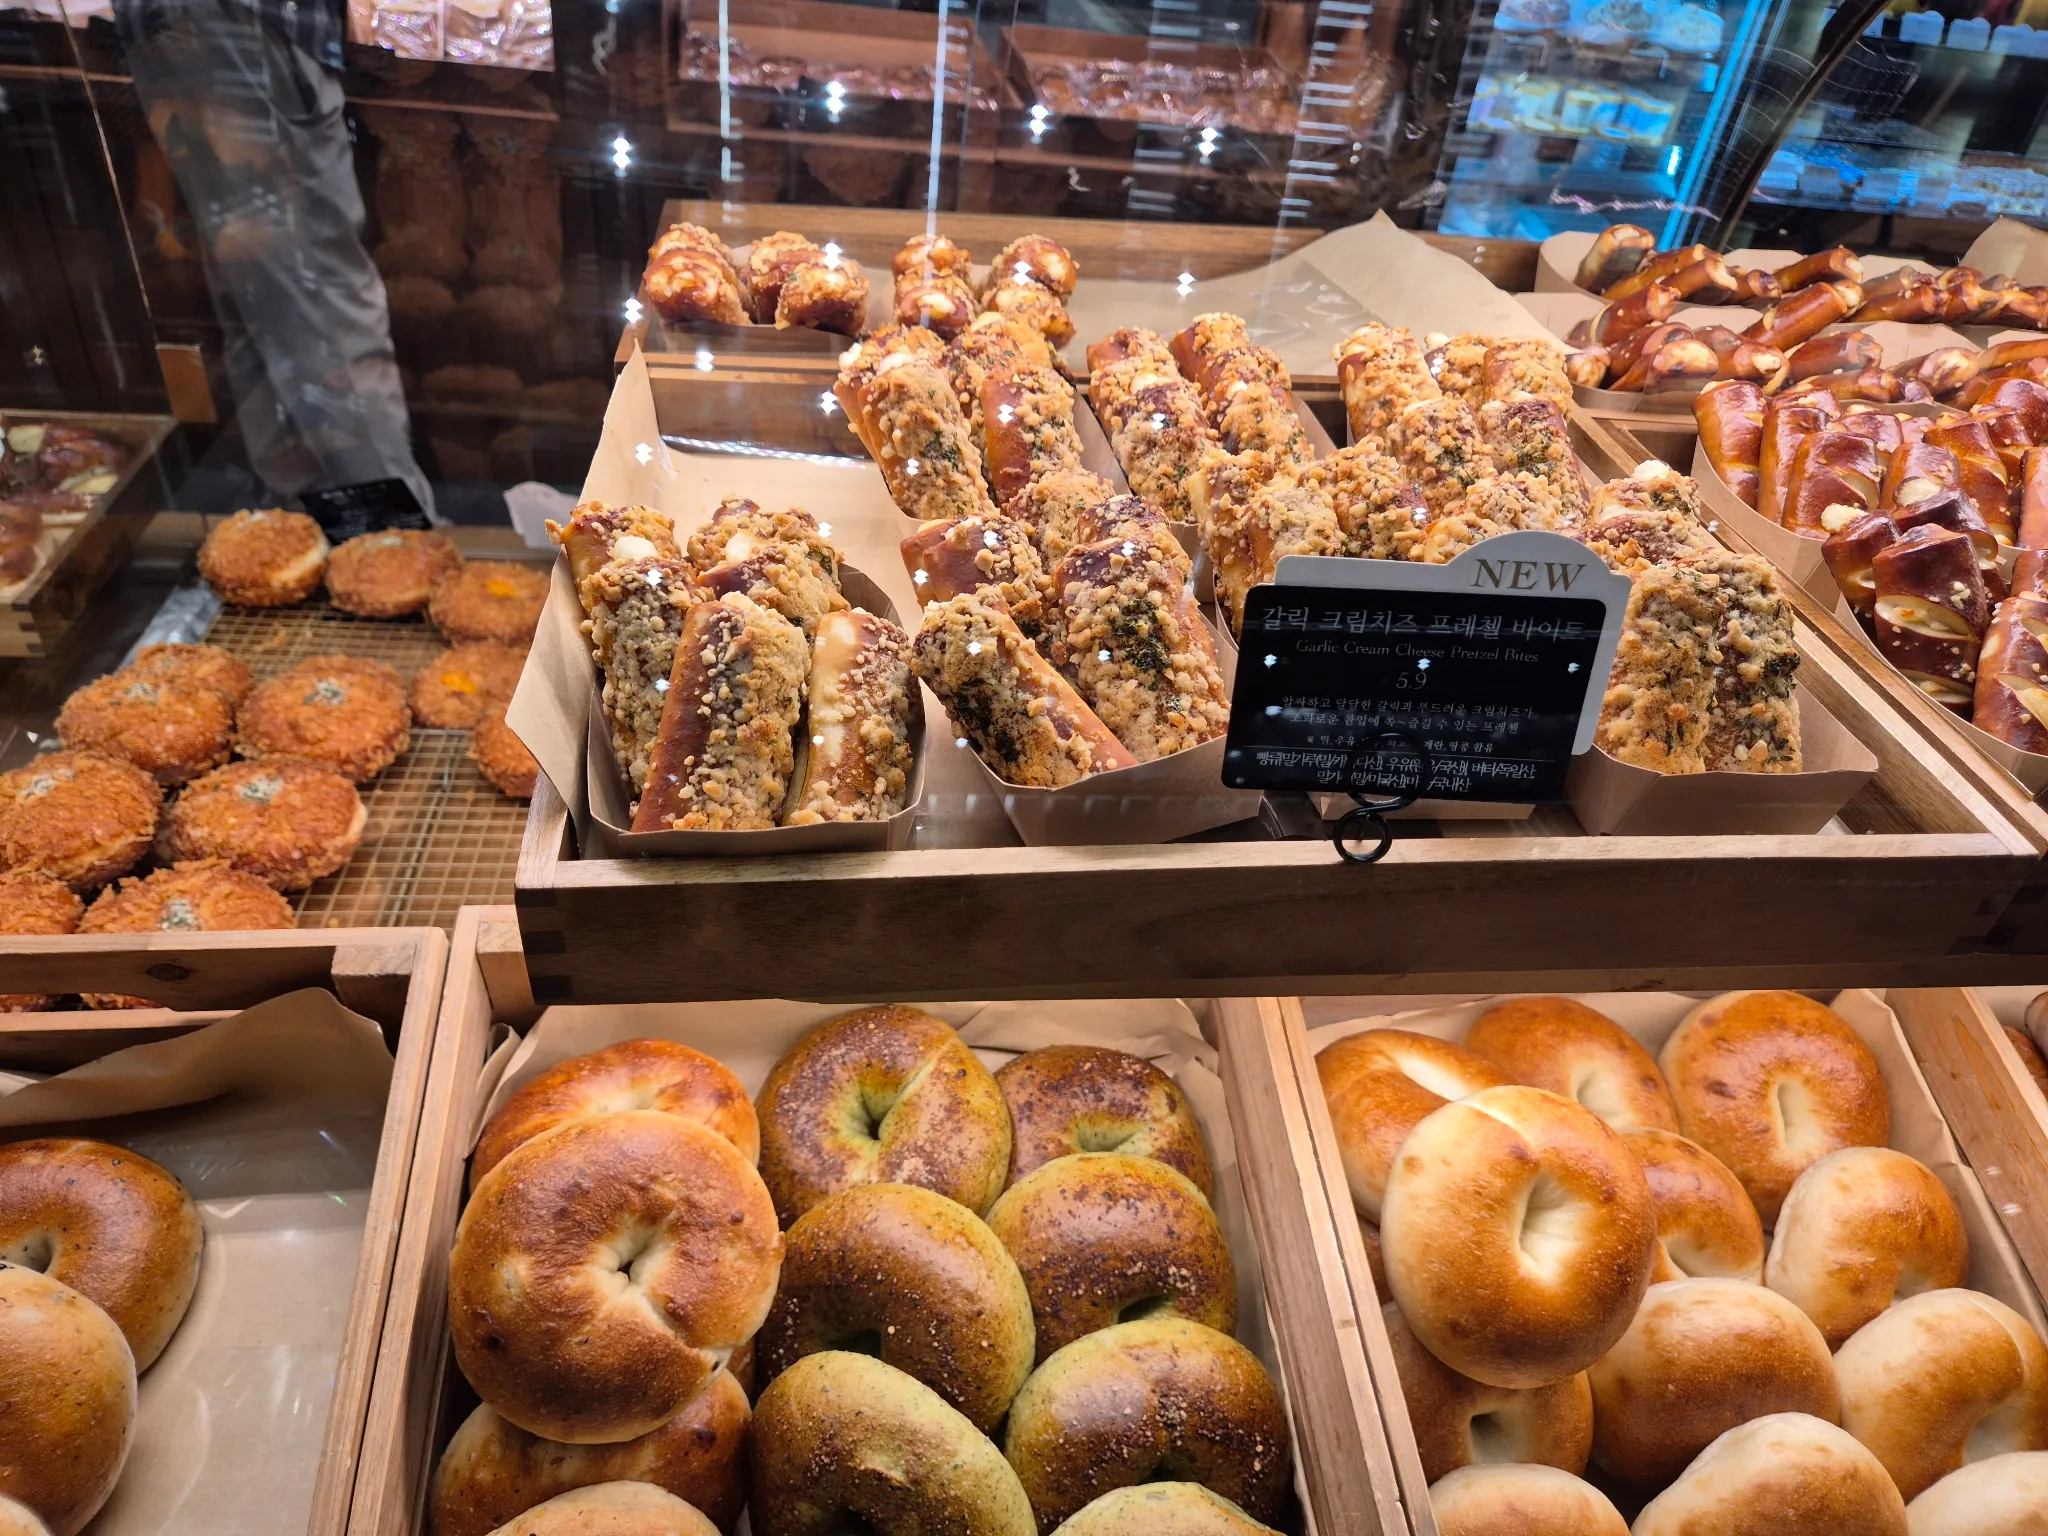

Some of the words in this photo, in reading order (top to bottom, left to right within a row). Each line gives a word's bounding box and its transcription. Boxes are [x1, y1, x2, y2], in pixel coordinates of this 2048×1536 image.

[1470, 559, 1587, 592] NEW
[1262, 605, 1309, 631] 갈릭
[1319, 609, 1418, 635] 크림치즈
[1426, 614, 1502, 640] 프레첼
[1513, 617, 1586, 643] 바이트
[1296, 639, 1339, 653] Garlic
[1344, 641, 1389, 655] Cream
[1395, 643, 1444, 658] Cheese
[1451, 645, 1499, 660] Pretzel
[1505, 648, 1539, 662] Bites
[1396, 671, 1427, 690] 5.9
[1282, 696, 1331, 708] 알싸하고
[1336, 698, 1372, 711] 달달한
[1377, 700, 1414, 712] 갈릭과
[1417, 702, 1466, 715] 부드러운
[1471, 705, 1534, 719] 크림치즈가
[1344, 714, 1380, 727] 한입에
[1437, 718, 1448, 730] 수
[1454, 719, 1477, 731] 있는
[1481, 722, 1520, 735] 프레첼
[1474, 742, 1494, 753] 함유
